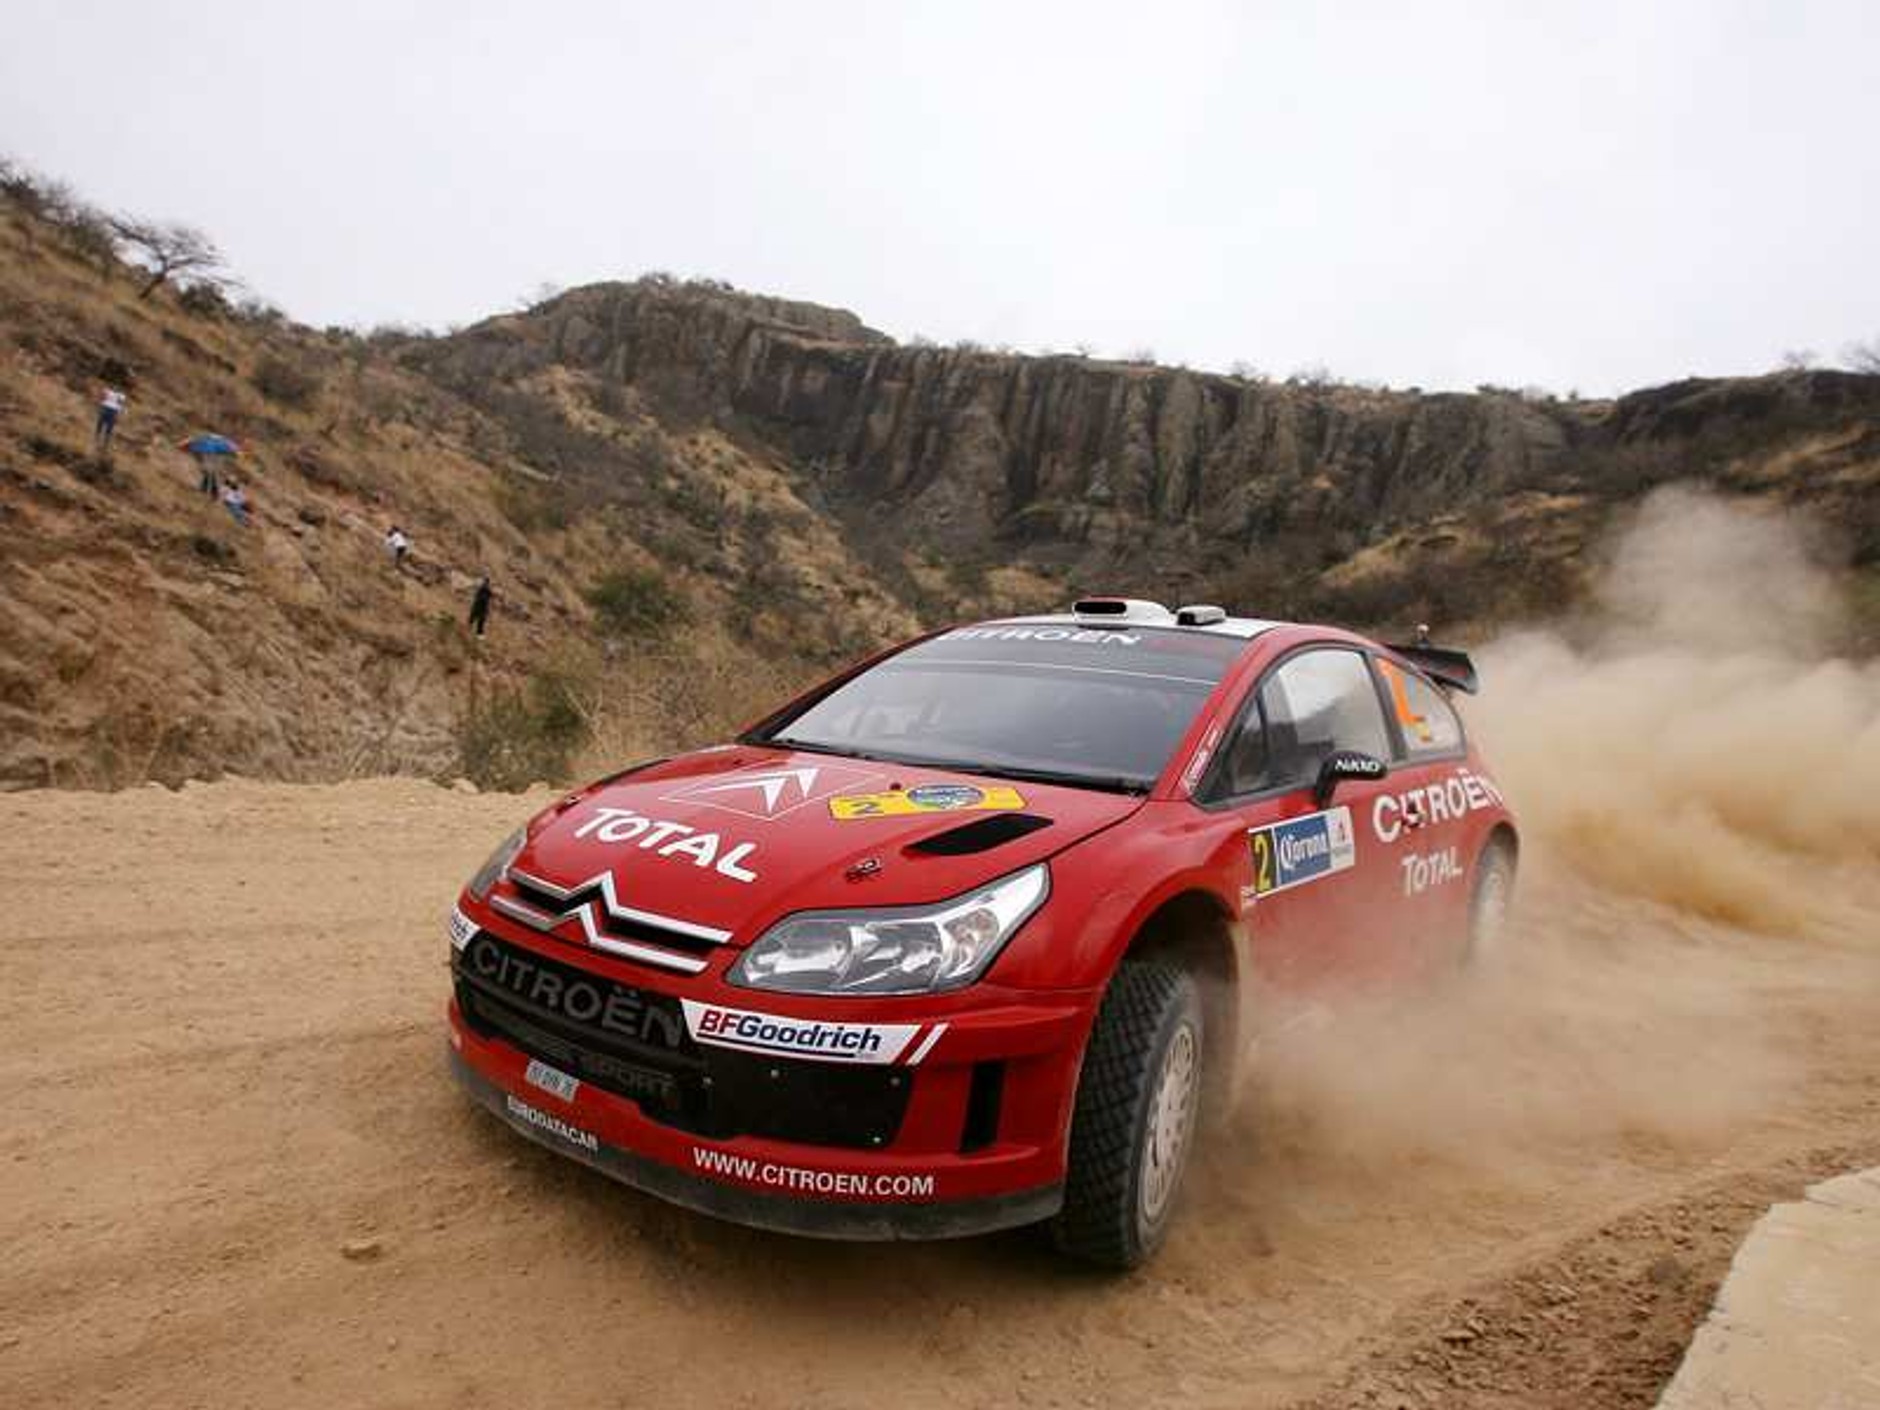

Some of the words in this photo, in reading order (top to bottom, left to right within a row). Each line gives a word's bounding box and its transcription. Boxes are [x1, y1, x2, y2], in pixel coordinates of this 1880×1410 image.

[575, 807, 758, 882] TOTAL
[1254, 832, 1272, 892] 2
[1281, 832, 1329, 870] Corona
[1401, 845, 1463, 897] TOTAL
[472, 938, 684, 1048] CITROËN
[699, 1009, 882, 1051] BFGoodrich
[693, 1146, 935, 1195] WWW.CITROEN.COM
